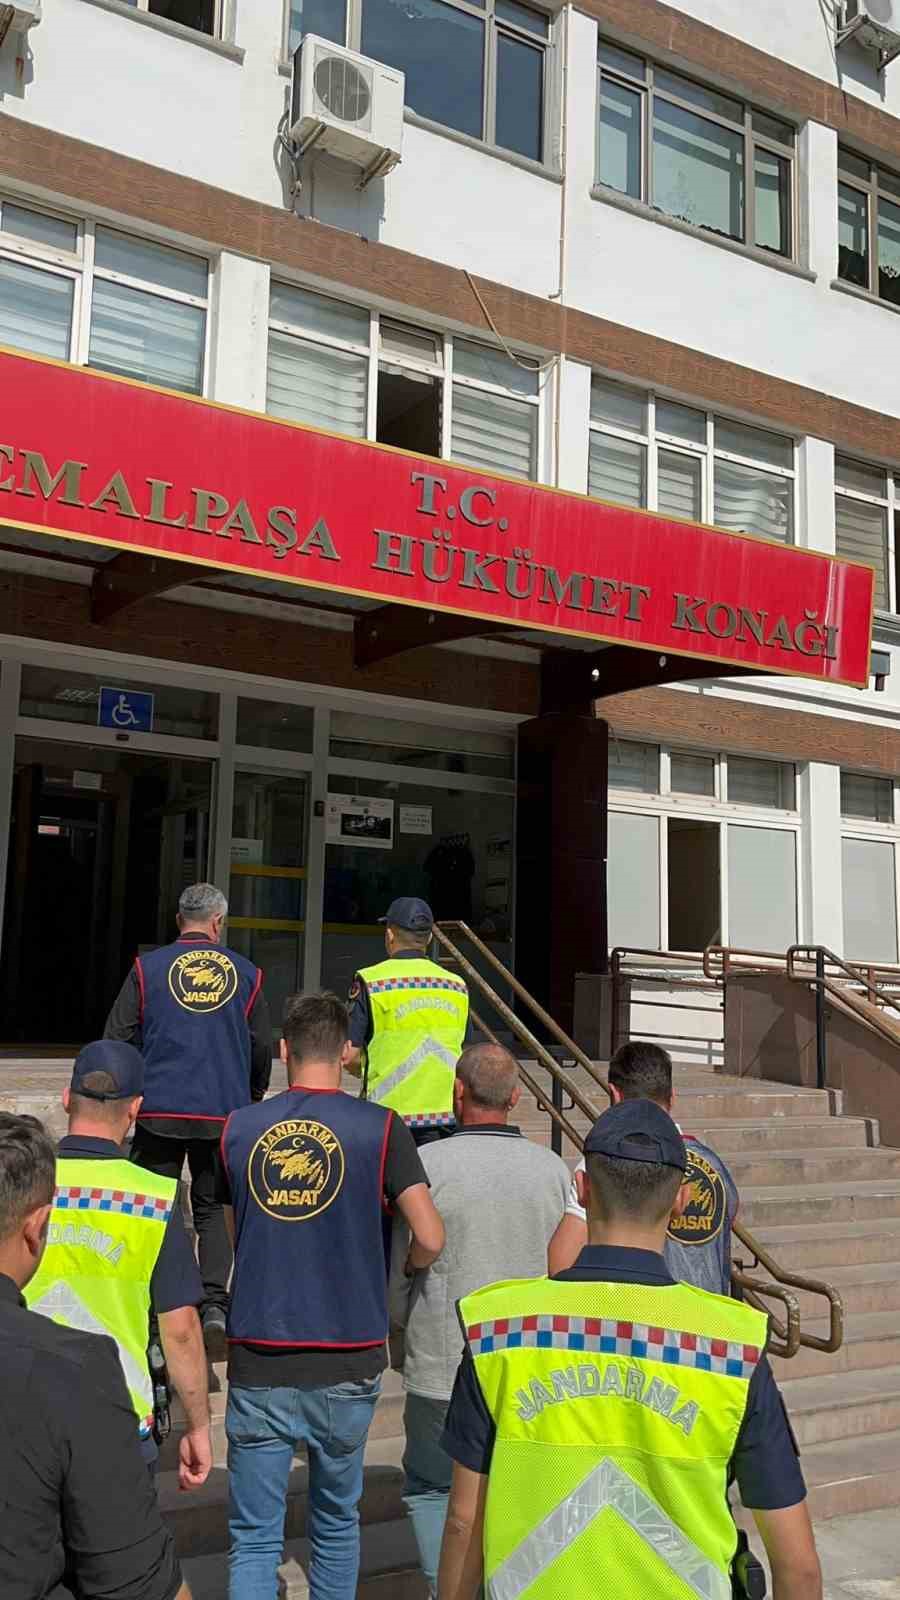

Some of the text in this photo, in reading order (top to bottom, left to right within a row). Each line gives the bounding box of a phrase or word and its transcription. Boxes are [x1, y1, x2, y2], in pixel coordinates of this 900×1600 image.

[411, 472, 509, 532] T.C.
[370, 527, 651, 622] HÜKÜMET
[671, 592, 839, 660] KONAĞI
[176, 951, 232, 972] JANDARMA
[183, 991, 222, 1003] JASAT
[260, 1121, 338, 1155] JANDARMA
[267, 1189, 321, 1206] JASAT
[515, 1363, 701, 1437] JANDARMA
